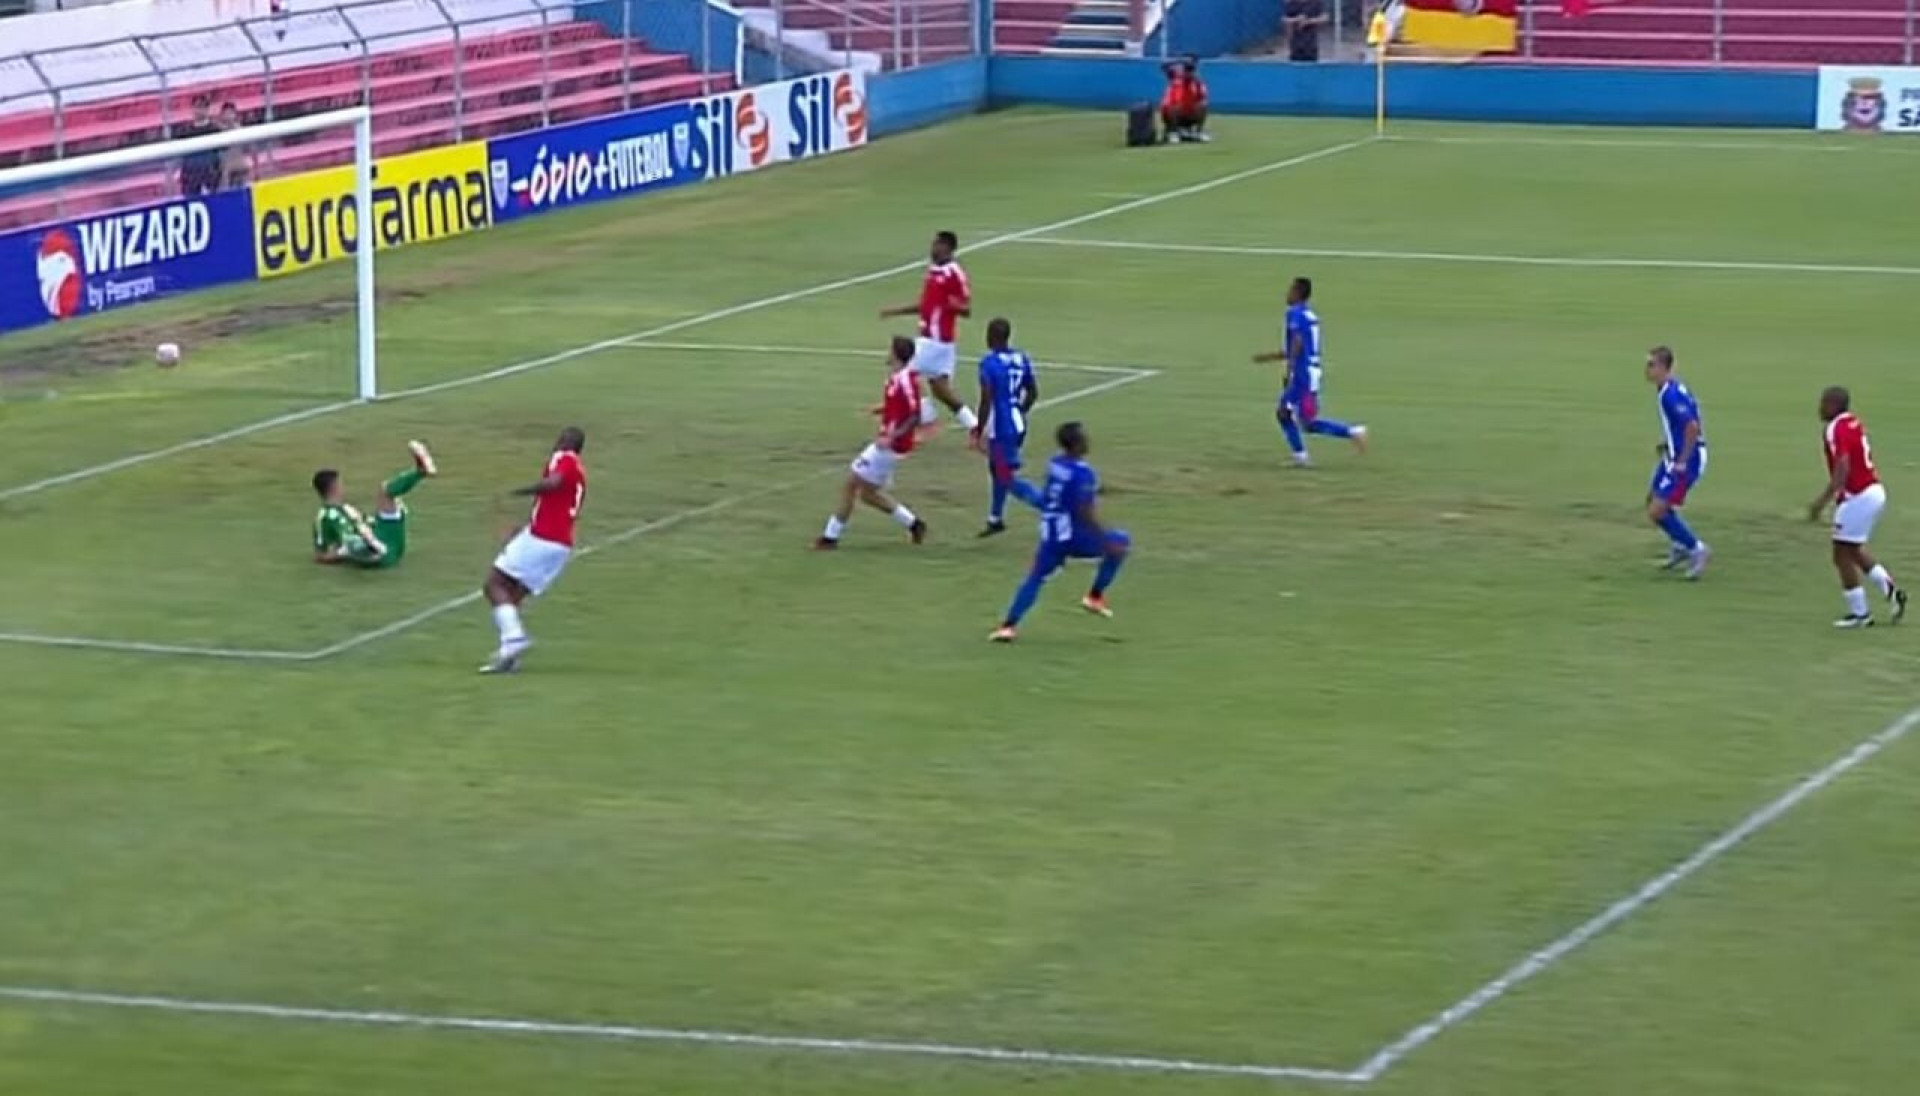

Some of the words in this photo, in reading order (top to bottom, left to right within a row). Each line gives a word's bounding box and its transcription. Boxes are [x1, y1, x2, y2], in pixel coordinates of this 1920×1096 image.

[689, 97, 732, 178] Sil
[788, 76, 831, 157] Sil
[77, 202, 210, 274] WIZARD
[87, 282, 103, 311] by
[104, 276, 155, 303] Pearson
